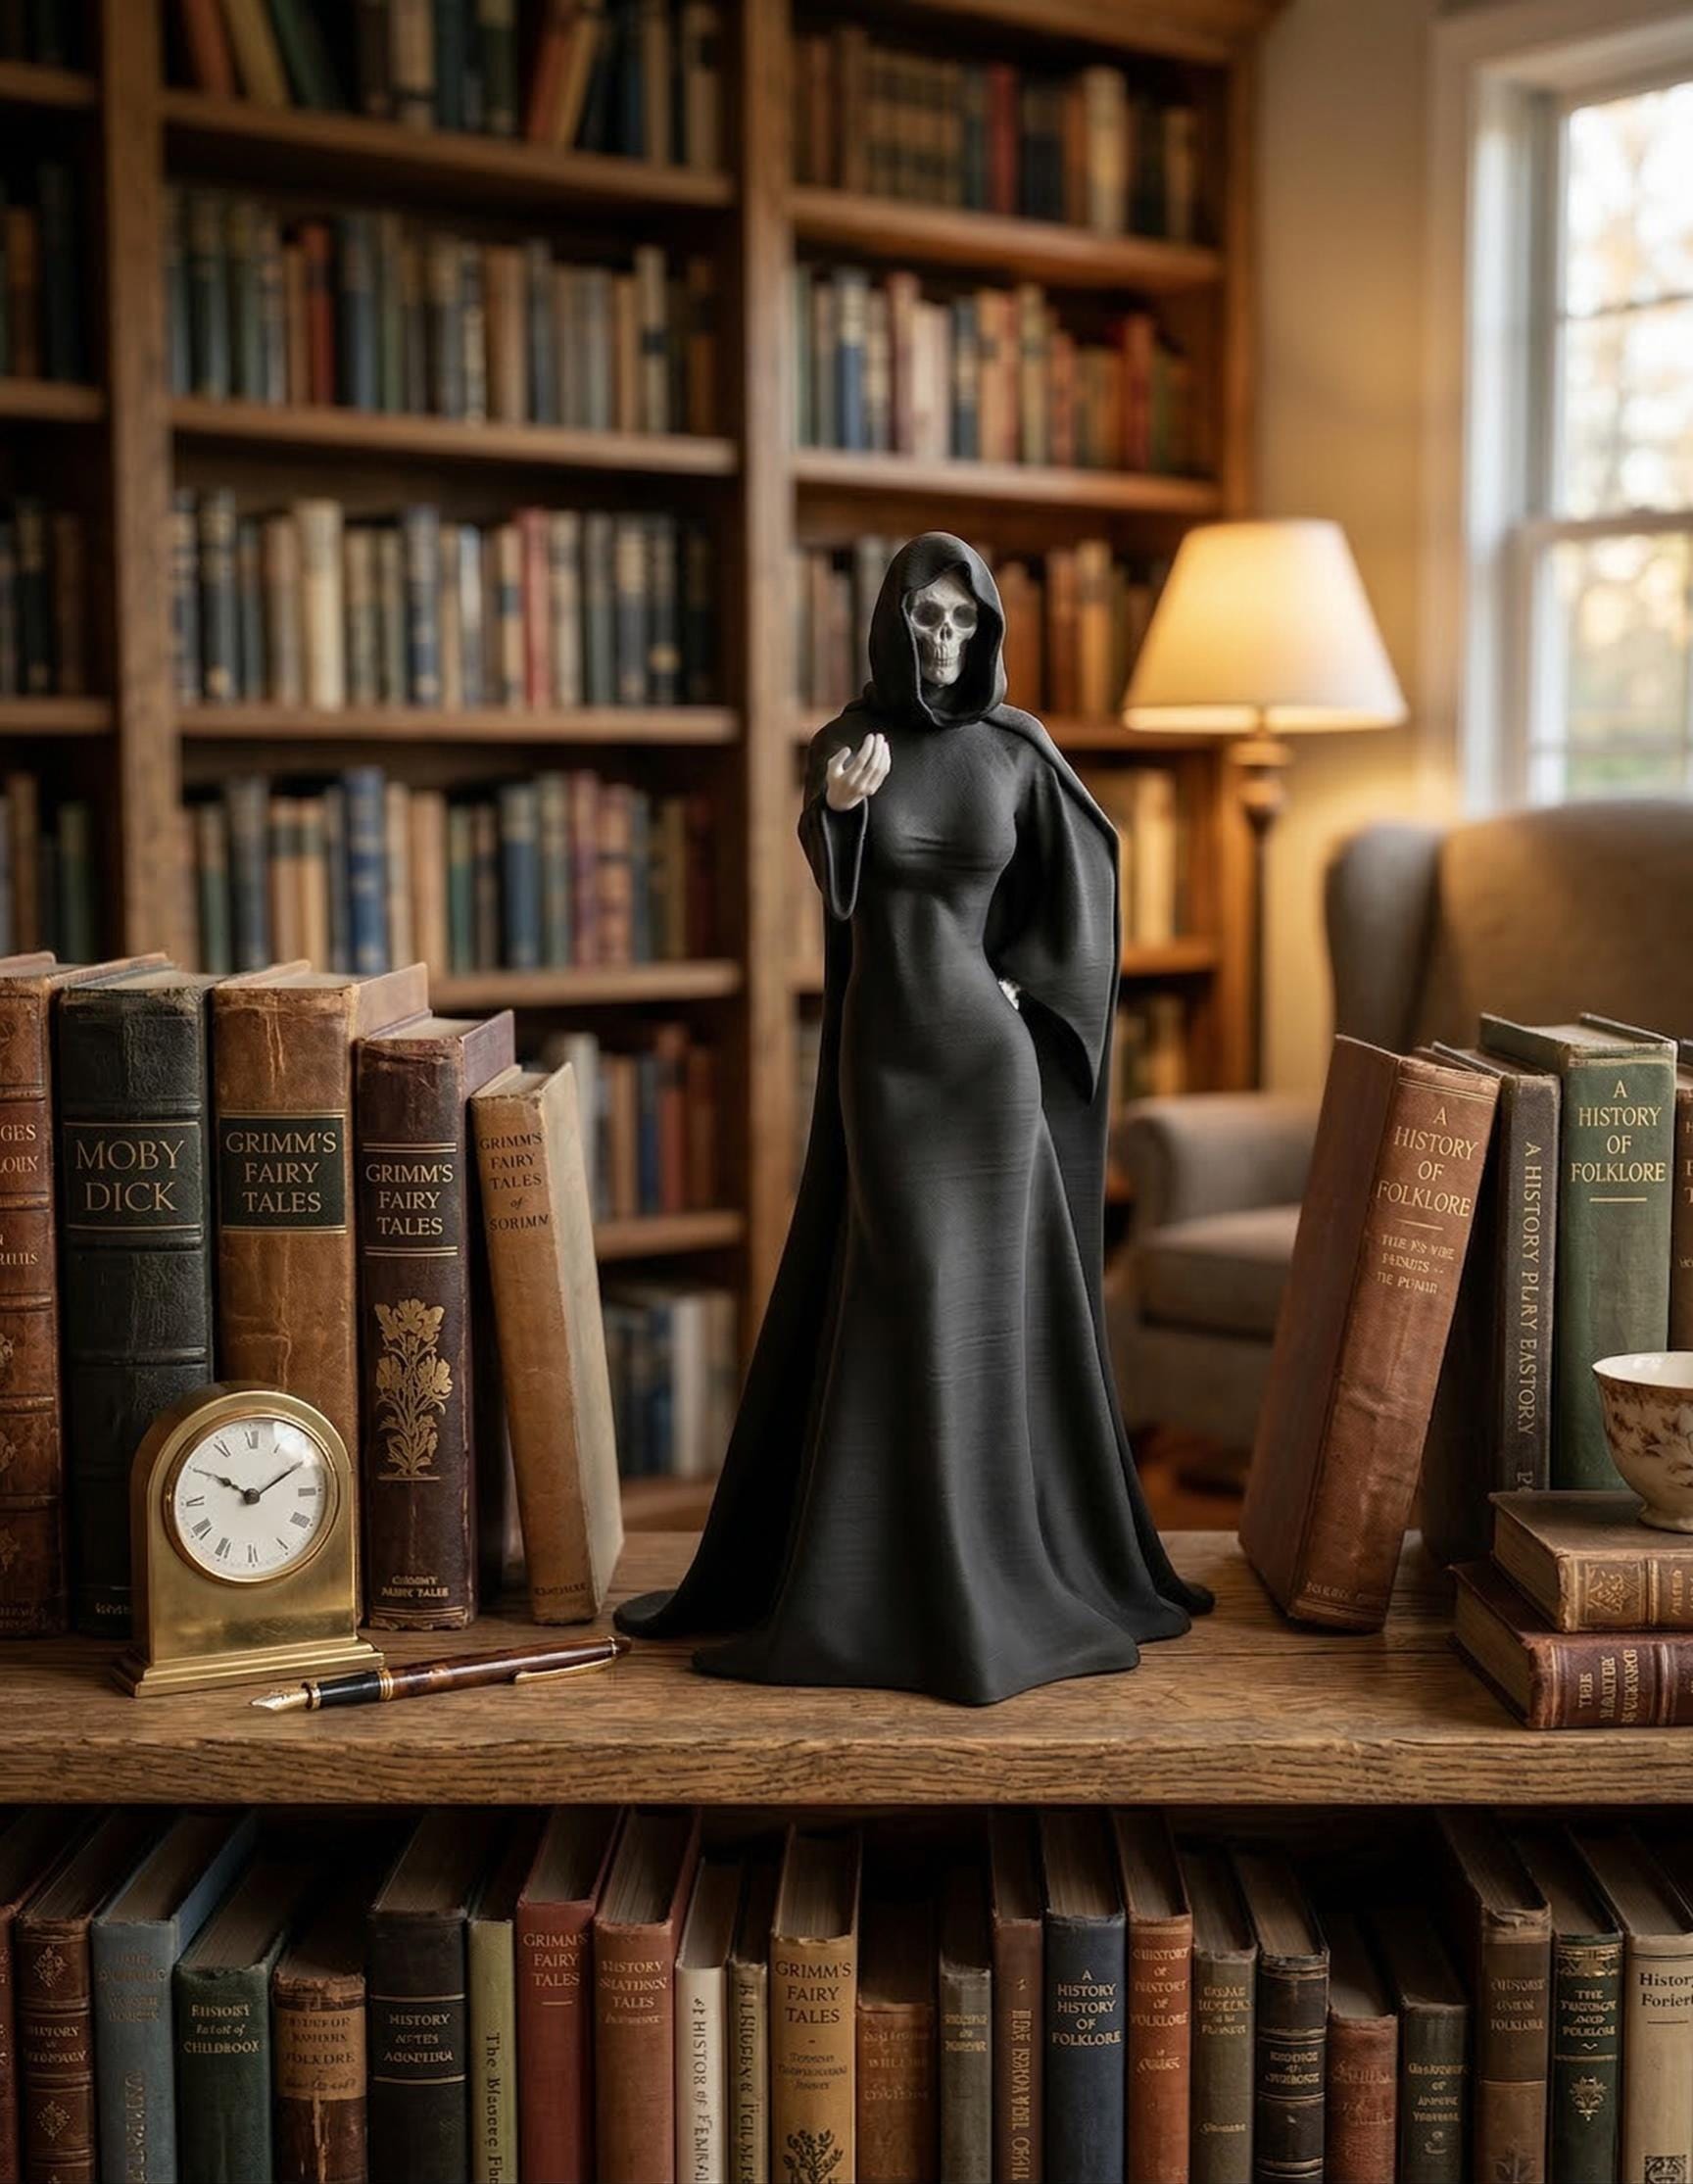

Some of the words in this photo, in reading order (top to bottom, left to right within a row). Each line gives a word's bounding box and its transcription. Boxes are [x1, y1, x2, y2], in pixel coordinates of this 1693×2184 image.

[1613, 1080, 1627, 1098] A
[1433, 1106, 1448, 1126] A
[1578, 1106, 1662, 1127] HISTORY
[225, 1131, 337, 1154] GRIMM'S
[1393, 1126, 1478, 1161] HISTORY
[1524, 1141, 1542, 1156] A
[1606, 1135, 1632, 1154] OF
[75, 1140, 185, 1171] MOBY
[491, 1153, 534, 1170] FAIRY
[244, 1162, 320, 1184] FAIRY
[365, 1163, 454, 1184] GRIMM'S
[1418, 1160, 1445, 1182] OF
[1571, 1162, 1666, 1183] FOLKLORE
[489, 1173, 542, 1190] TALES
[85, 1182, 178, 1212] DICK
[242, 1191, 321, 1213] TALES
[378, 1190, 442, 1209] FAIRY
[510, 1197, 523, 1210] of
[1377, 1181, 1472, 1217] FOLKLORE
[1523, 1166, 1542, 1264] HISTORY
[376, 1217, 444, 1236] TALES
[534, 1953, 580, 1968] FAIRY
[775, 1961, 851, 1979] GRIMM'S
[533, 1972, 581, 1987] TALES
[1082, 1969, 1092, 1981] A
[787, 1985, 840, 2001] FAIRY
[1057, 1983, 1117, 1997] HISTORY
[785, 2008, 840, 2023] TALES
[1057, 2000, 1117, 2014] HISTORY
[389, 2013, 451, 2026] HISTORY
[1076, 2017, 1096, 2030] OF
[1051, 2030, 1122, 2046] FOLKLORE
[485, 2032, 501, 2067] The
